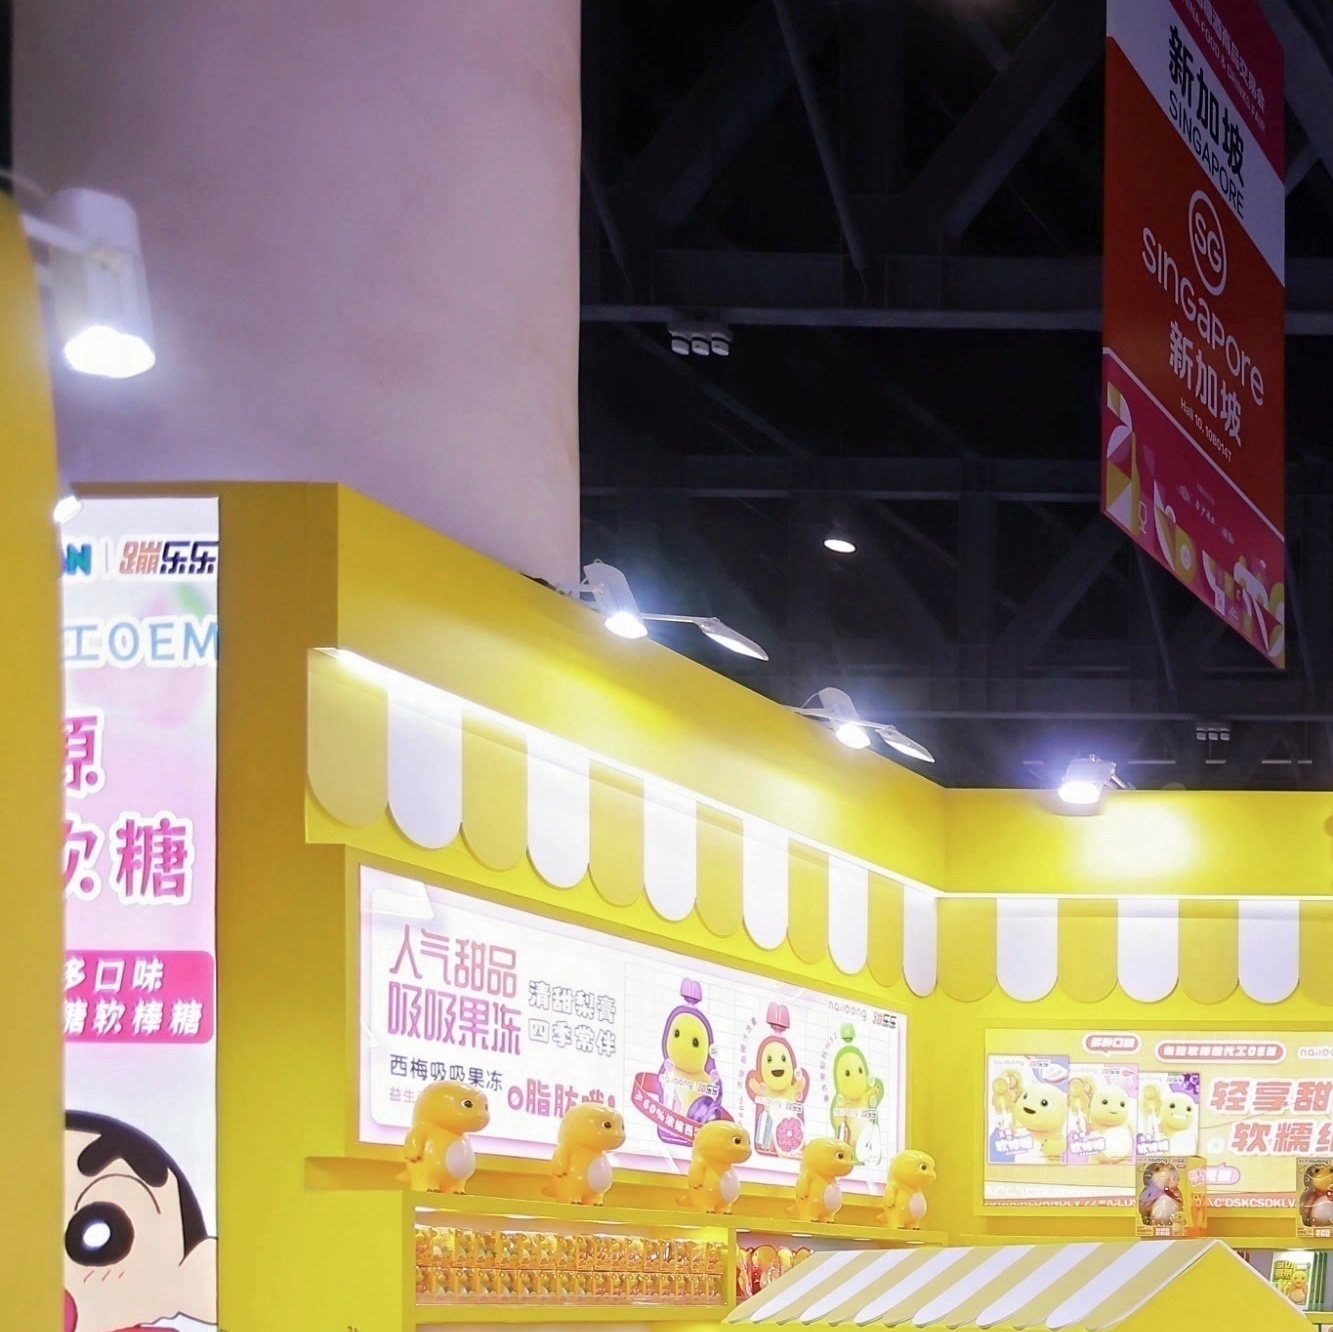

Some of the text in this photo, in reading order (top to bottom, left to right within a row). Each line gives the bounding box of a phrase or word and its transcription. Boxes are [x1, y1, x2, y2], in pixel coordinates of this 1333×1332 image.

[1169, 24, 1244, 187] 新加坡
[1169, 89, 1244, 220] SINGAPORE
[1169, 321, 1242, 448] 新加坡
[389, 924, 517, 999] 人气甜品
[388, 981, 521, 1056] 吸吸果冻
[528, 979, 617, 1024] 清甜梨膏
[528, 1017, 617, 1057] 四季常伴
[389, 1053, 504, 1092] 西梅吸吸果冻
